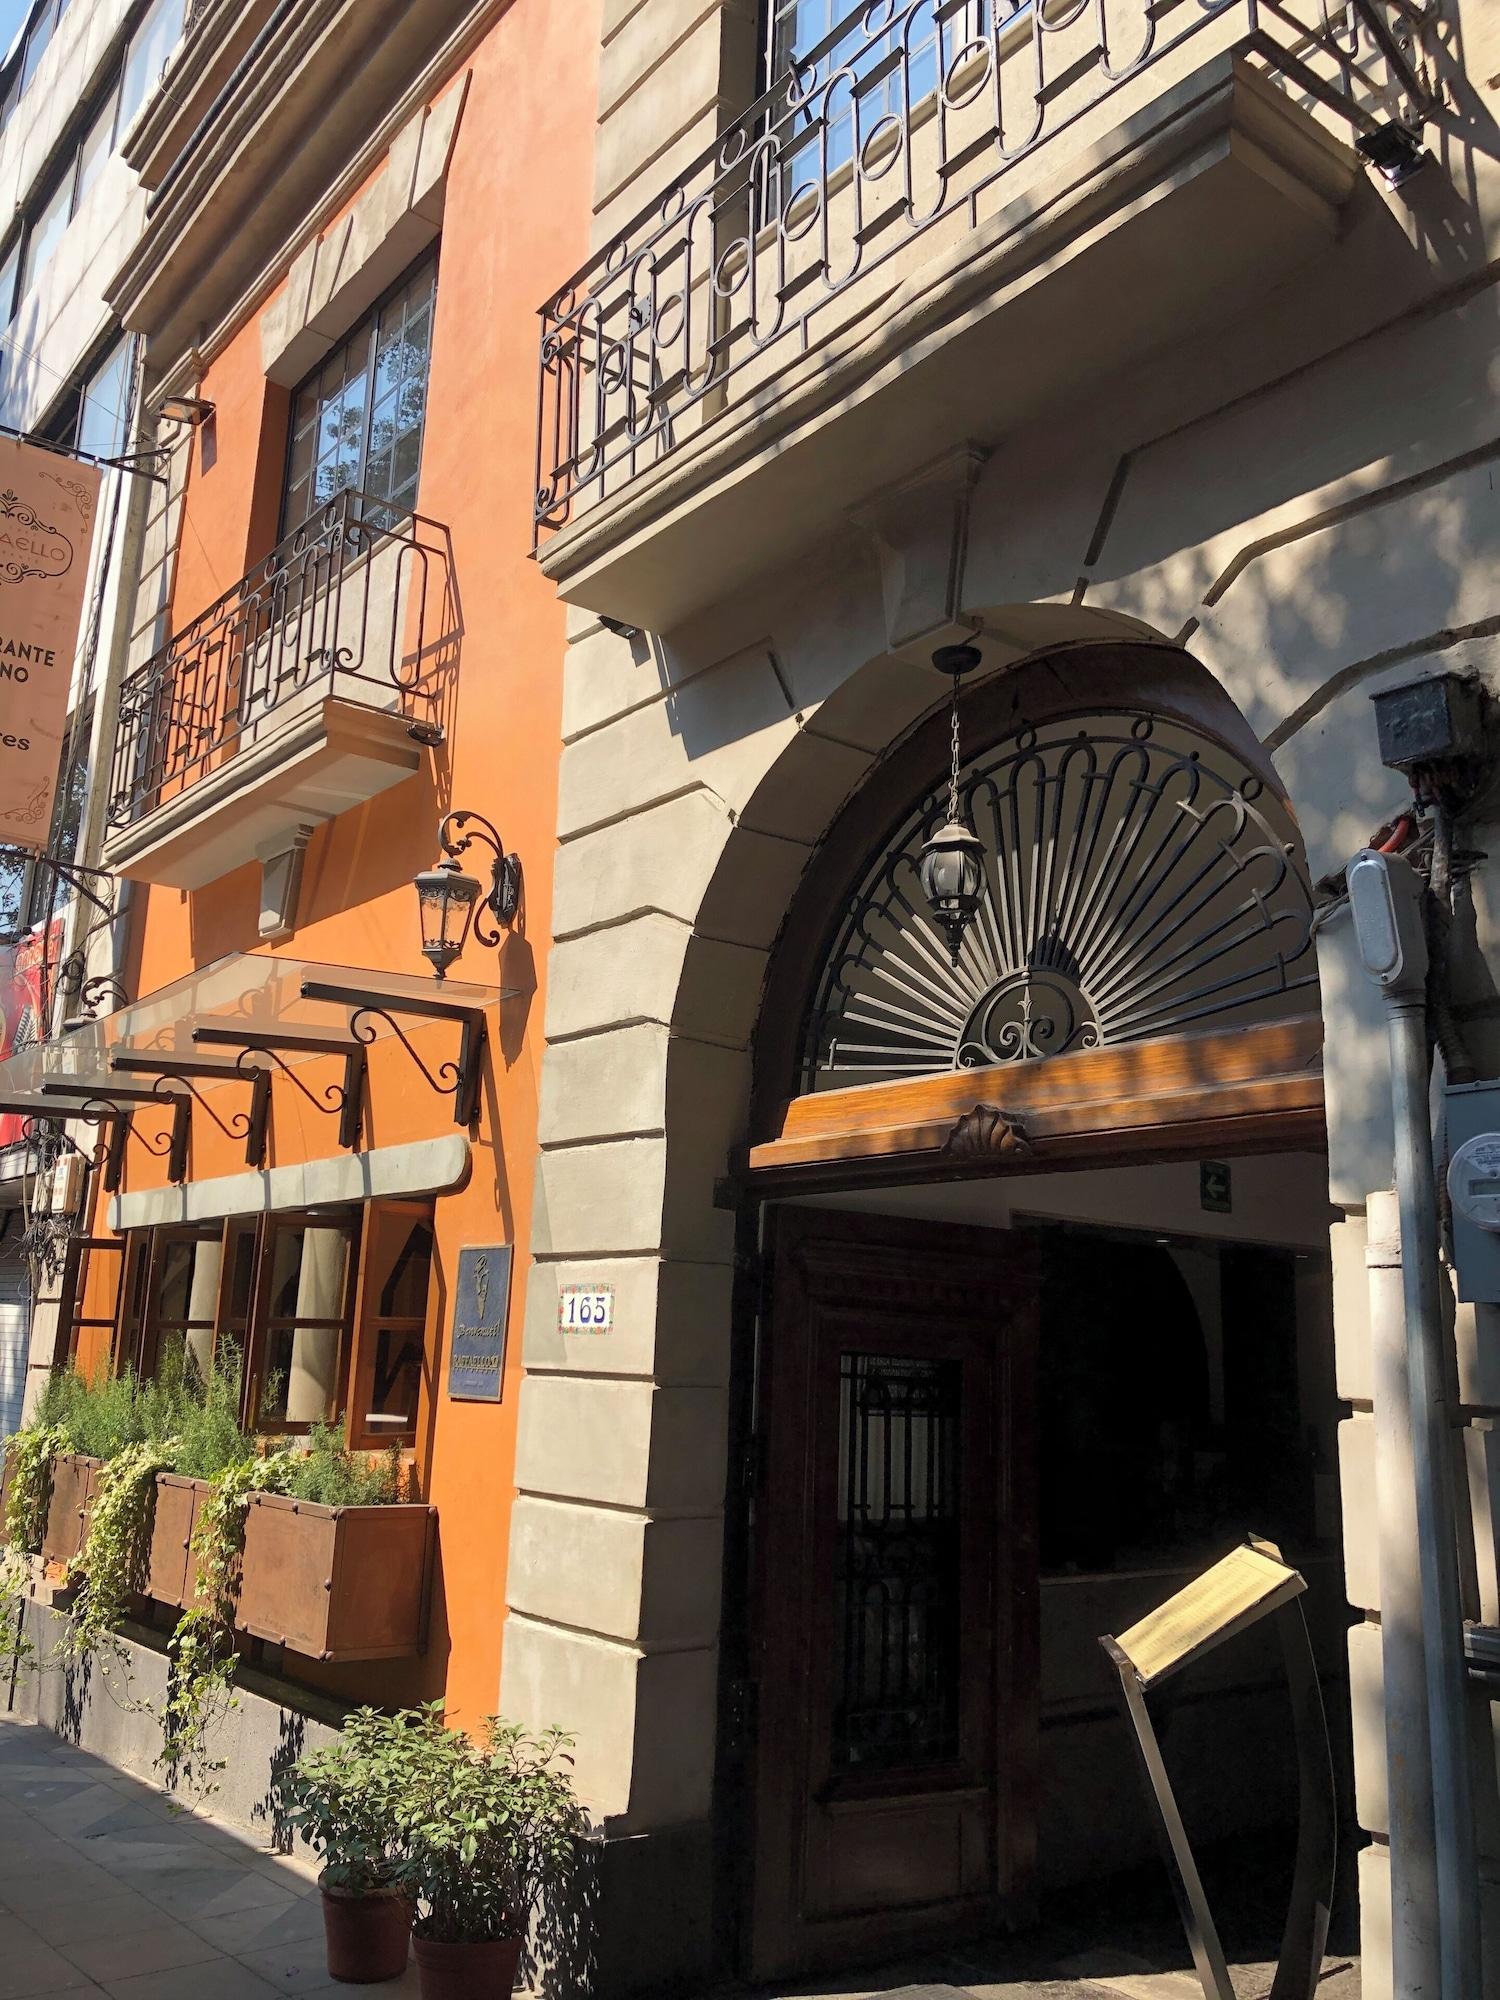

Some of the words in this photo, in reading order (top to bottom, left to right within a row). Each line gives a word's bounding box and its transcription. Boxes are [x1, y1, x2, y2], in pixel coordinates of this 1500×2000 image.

[0, 637, 56, 667] ANTE
[0, 733, 30, 750] es
[568, 1296, 606, 1324] 165
